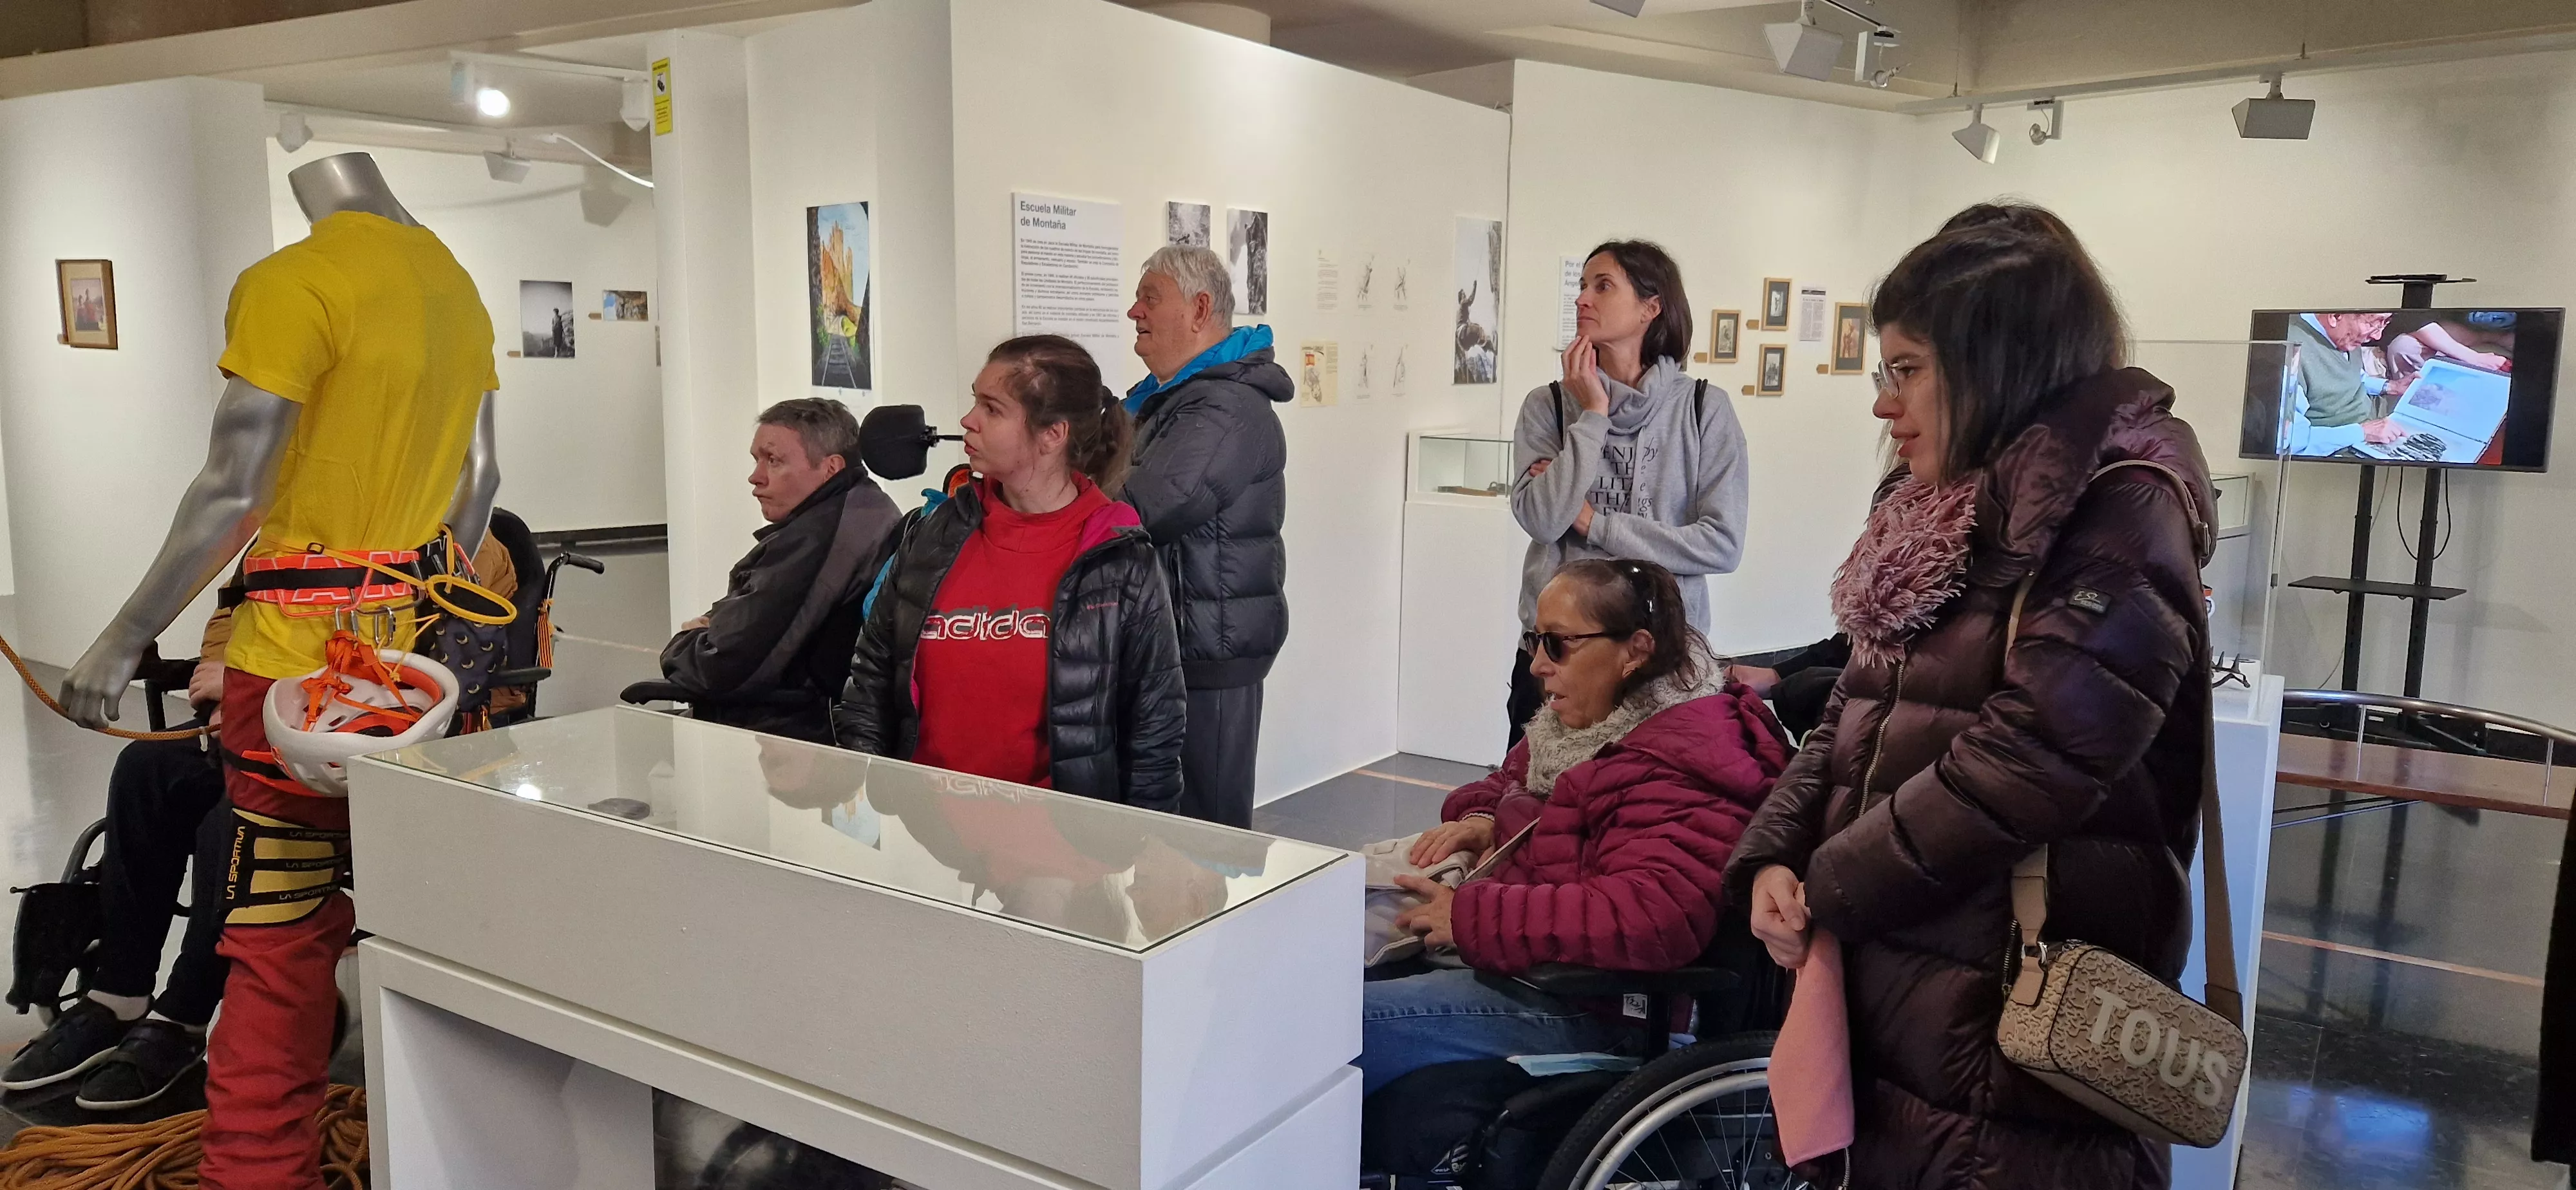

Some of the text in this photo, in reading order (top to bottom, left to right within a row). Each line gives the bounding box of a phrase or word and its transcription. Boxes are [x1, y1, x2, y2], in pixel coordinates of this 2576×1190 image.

[1020, 200, 1077, 216] Escuela Militar
[1020, 216, 1066, 230] de Montaña
[920, 607, 1051, 641] adida
[225, 884, 236, 900] LA
[2090, 986, 2229, 1108] TOUS
